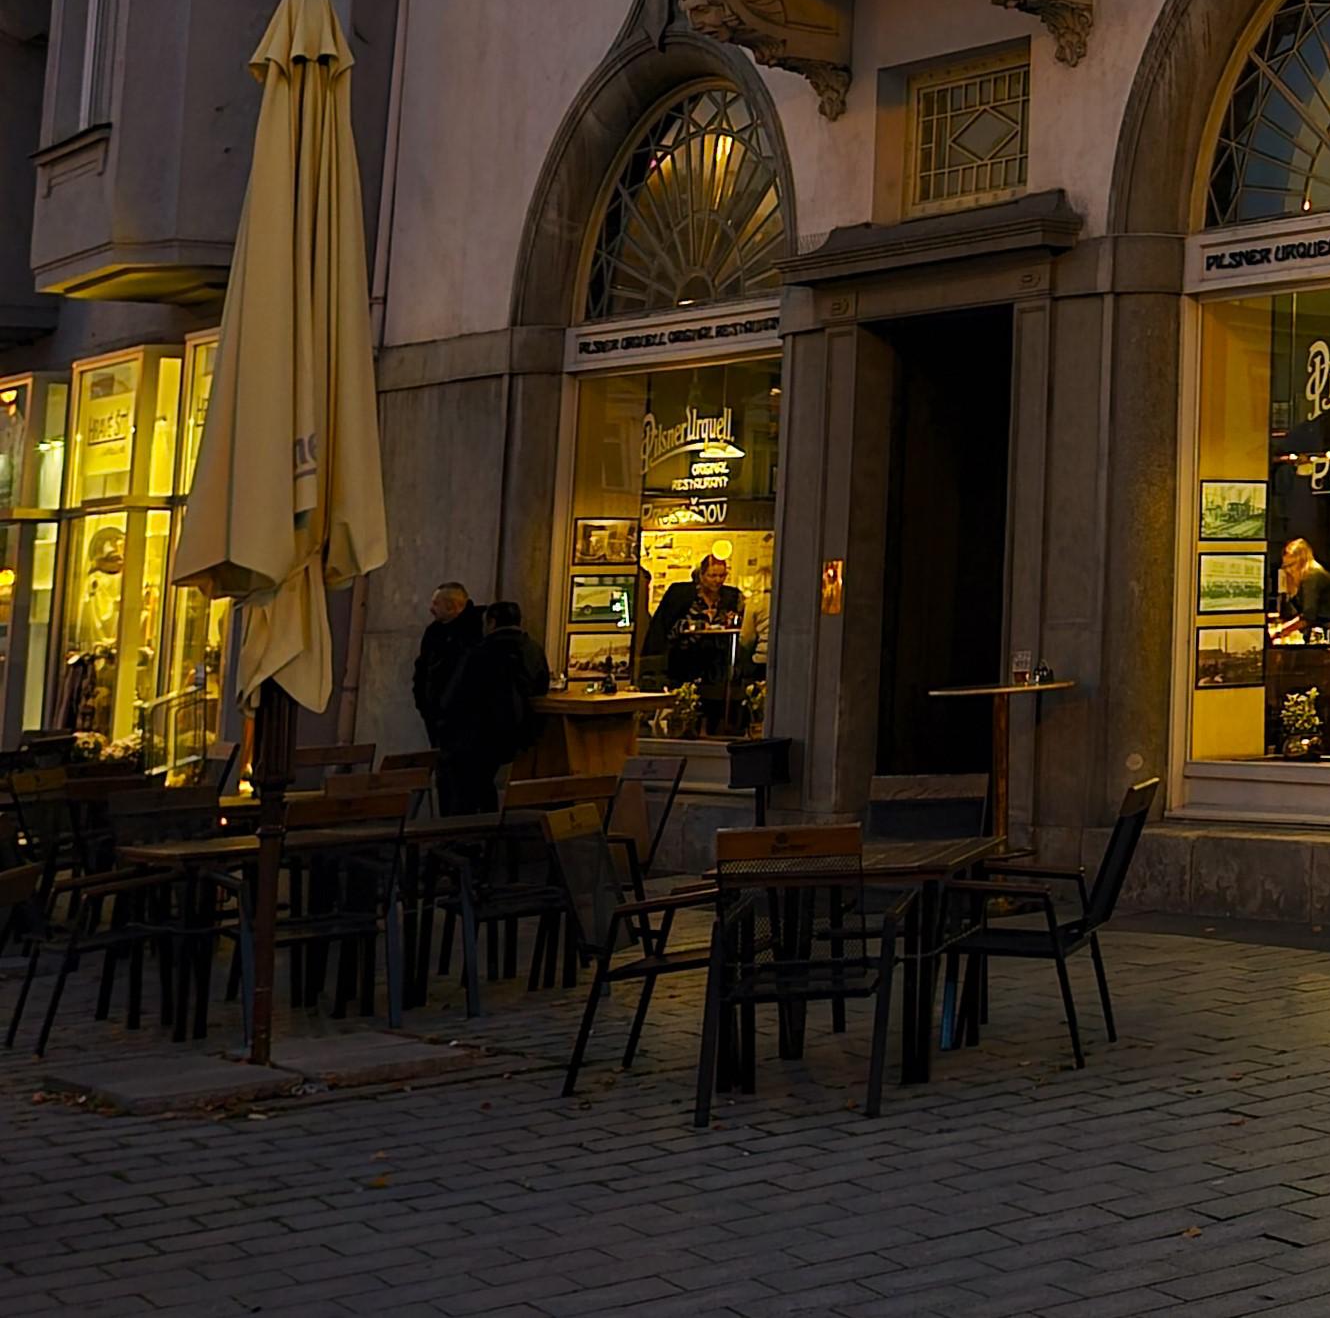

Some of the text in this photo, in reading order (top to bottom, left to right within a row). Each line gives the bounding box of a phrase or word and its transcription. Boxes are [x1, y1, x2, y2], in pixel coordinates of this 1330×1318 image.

[1205, 247, 1272, 271] PILSNER
[641, 405, 733, 475] Pilsner Urquell
[672, 476, 729, 491] RESTAURANT
